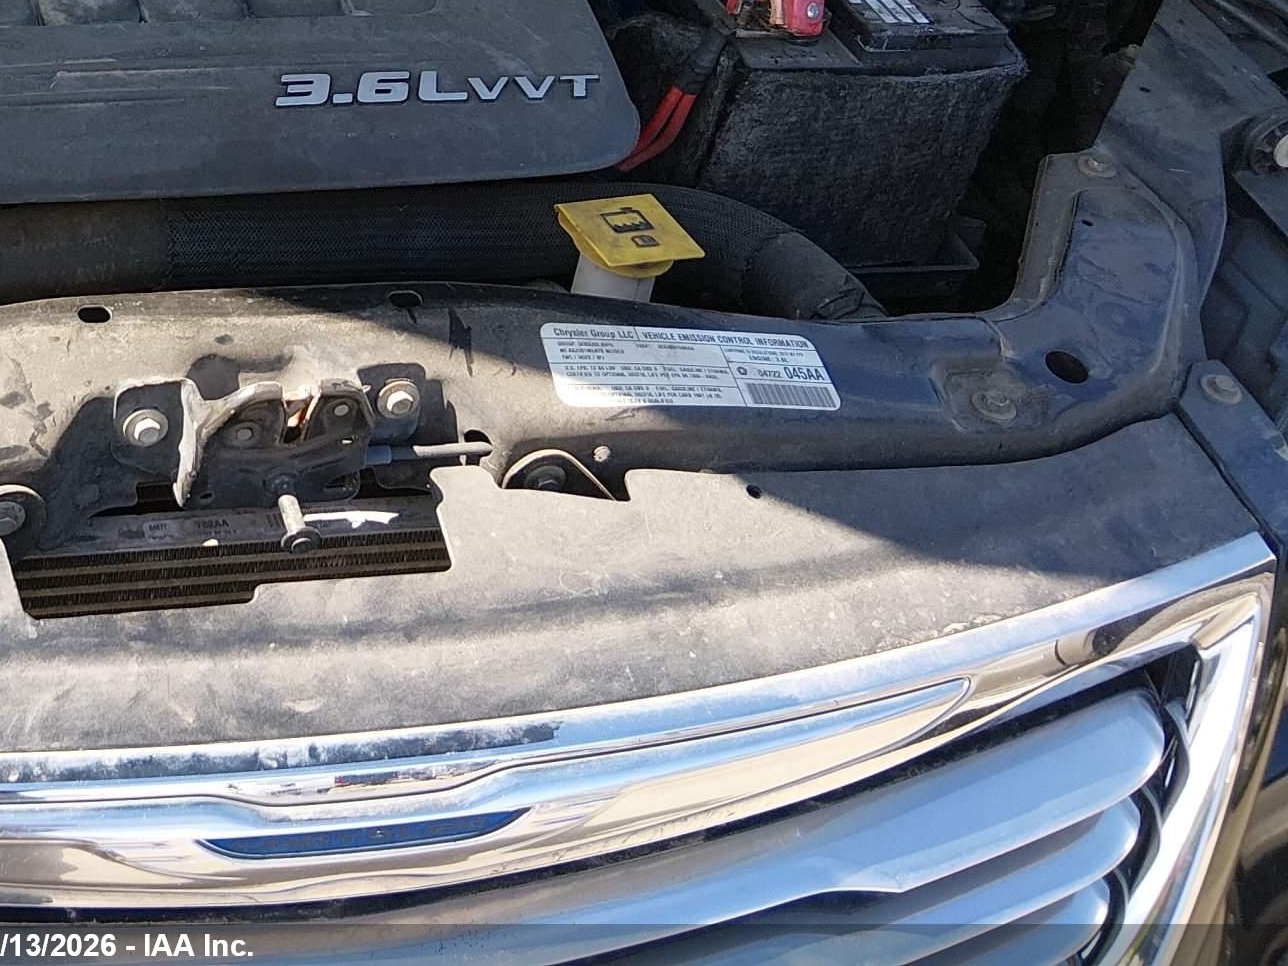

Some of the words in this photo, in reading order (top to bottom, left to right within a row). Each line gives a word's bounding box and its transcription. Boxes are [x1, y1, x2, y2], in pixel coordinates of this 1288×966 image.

[553, 327, 588, 338] Chrysler
[590, 328, 616, 339] Group
[617, 329, 634, 339] LLC
[642, 331, 676, 341] VEHICLE
[678, 333, 714, 343] EMISSION
[716, 335, 753, 346] CONTROL
[755, 337, 809, 348] INFORMATION
[783, 366, 826, 381] 045AA
